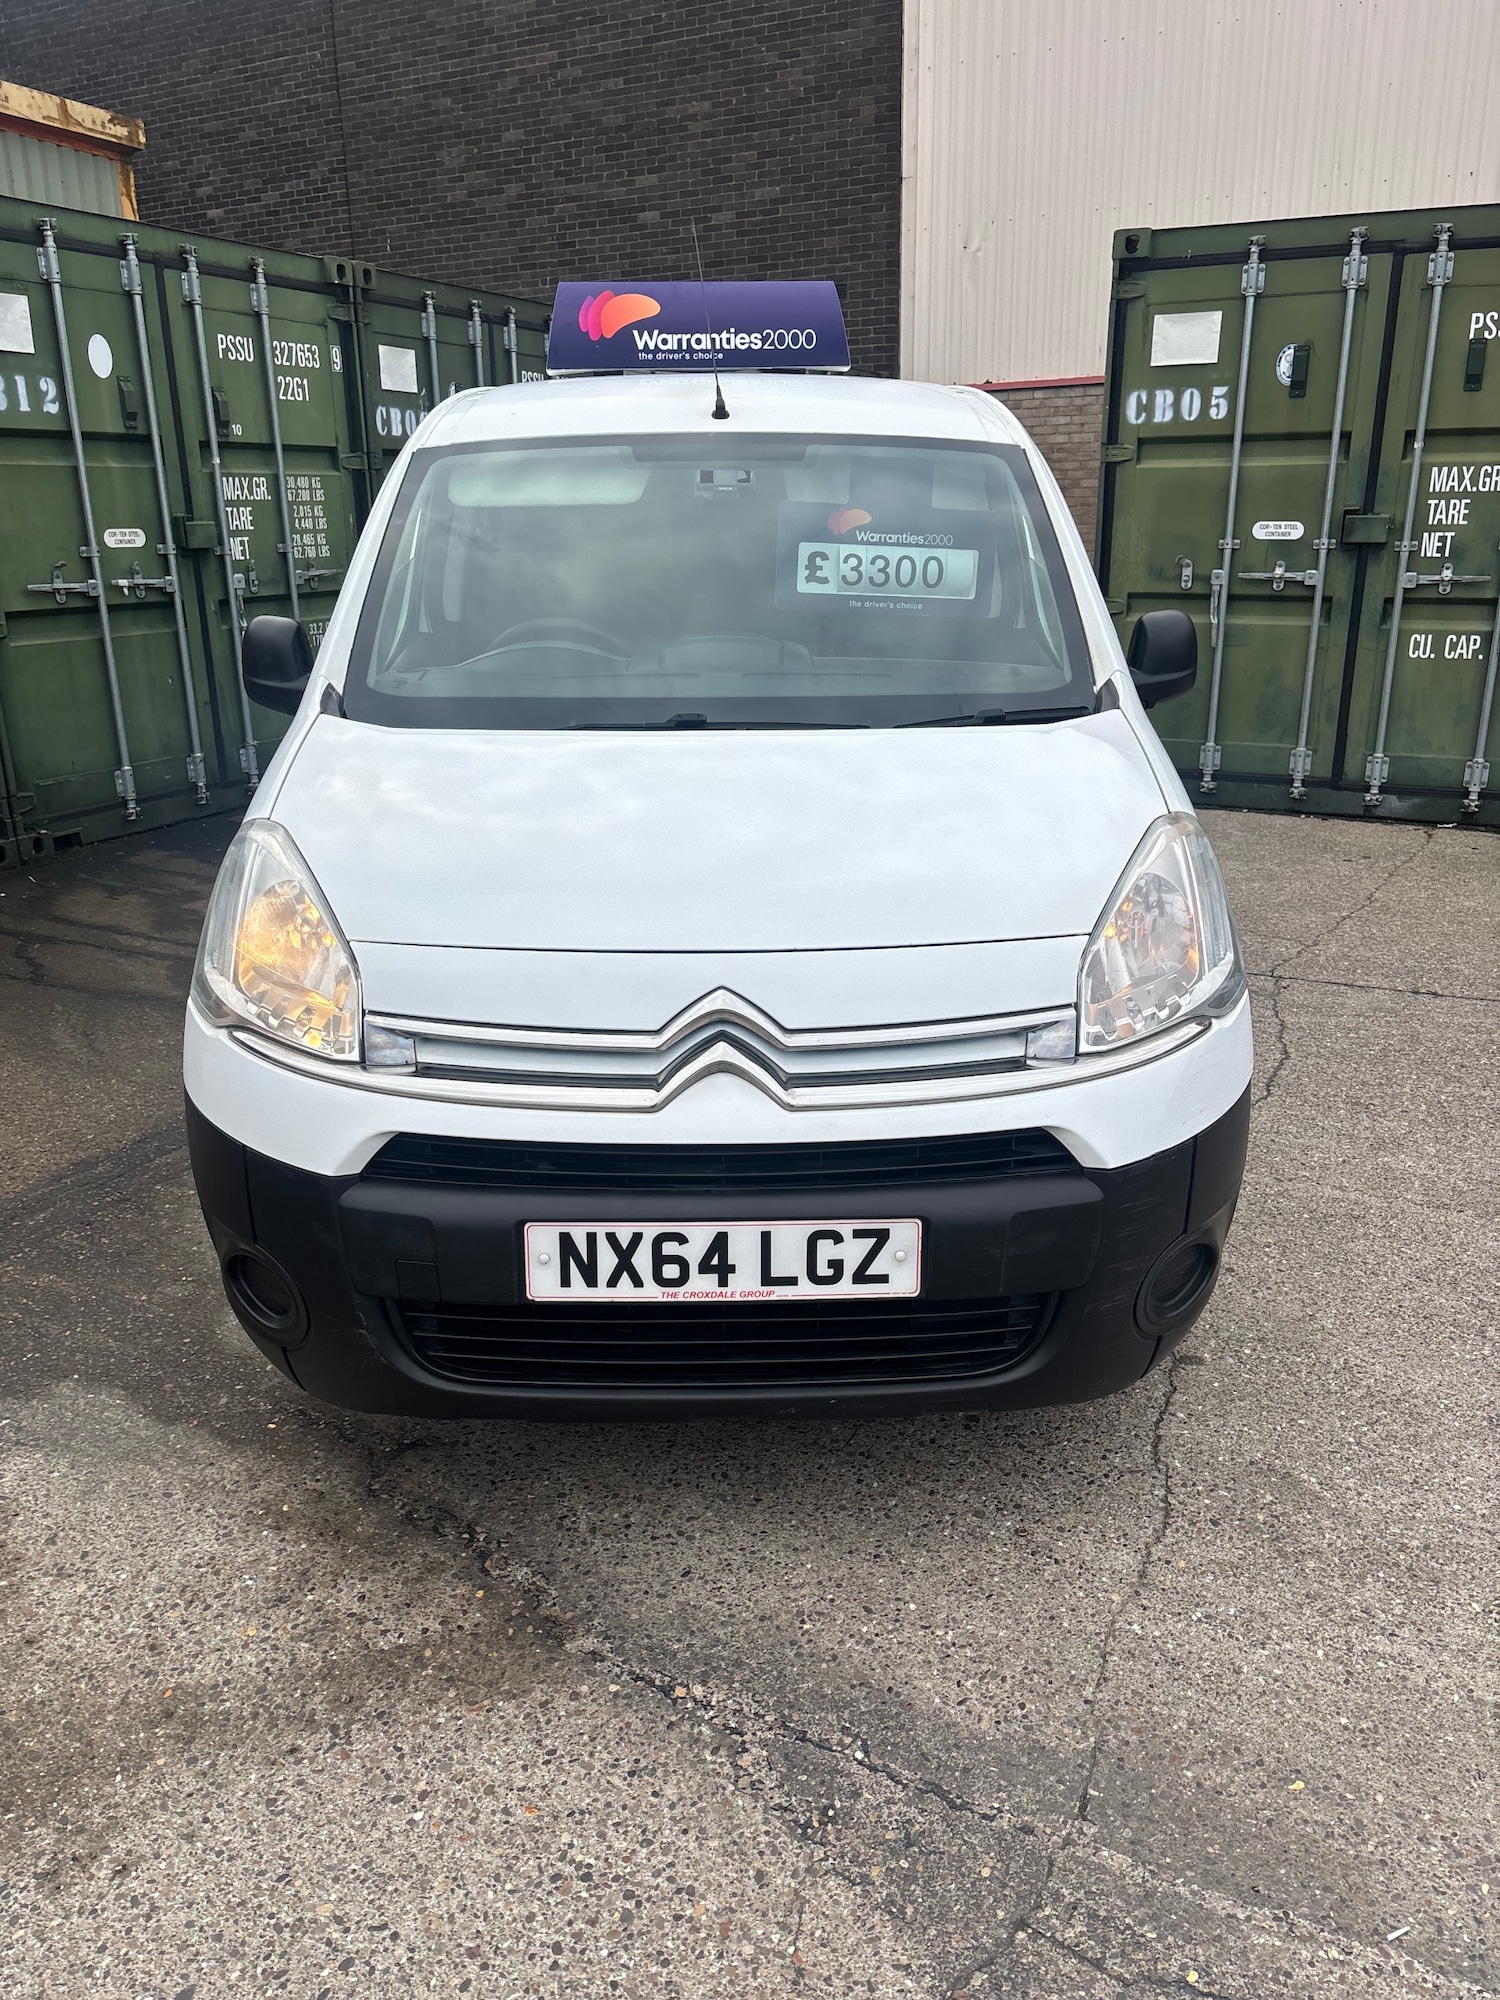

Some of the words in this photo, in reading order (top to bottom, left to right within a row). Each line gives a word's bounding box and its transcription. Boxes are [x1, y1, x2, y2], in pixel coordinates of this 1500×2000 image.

[1468, 311, 1500, 340] PS
[632, 328, 817, 350] Warranties2000
[217, 333, 254, 362] PSSU
[272, 340, 320, 368] 327653
[332, 347, 341, 371] 9
[638, 351, 647, 360] the
[656, 351, 691, 360] driver's
[693, 351, 724, 360] choice
[277, 375, 310, 401] 22G1
[1125, 385, 1230, 425] CB05
[231, 423, 243, 436] 10
[222, 476, 271, 501] MAX.GR.
[312, 477, 321, 489] KG
[312, 489, 325, 502] LBS
[225, 506, 255, 531] TARE
[314, 505, 324, 518] KG
[315, 517, 328, 530] LBS
[1427, 499, 1471, 525] TARE
[229, 536, 250, 561] NET
[317, 533, 327, 546] KG
[855, 529, 954, 547] Warranties2000
[1420, 532, 1456, 557] NET
[318, 545, 331, 558] LBS
[849, 599, 862, 608] the
[864, 600, 894, 610] driver's
[896, 601, 923, 610] choice
[1408, 633, 1436, 659] CU.
[1444, 634, 1484, 660] CAP.
[558, 1231, 736, 1288] NX64
[760, 1228, 891, 1287] LGZ
[661, 1291, 681, 1299] THE
[682, 1290, 738, 1299] CROXDALE
[739, 1290, 776, 1298] GROUP
